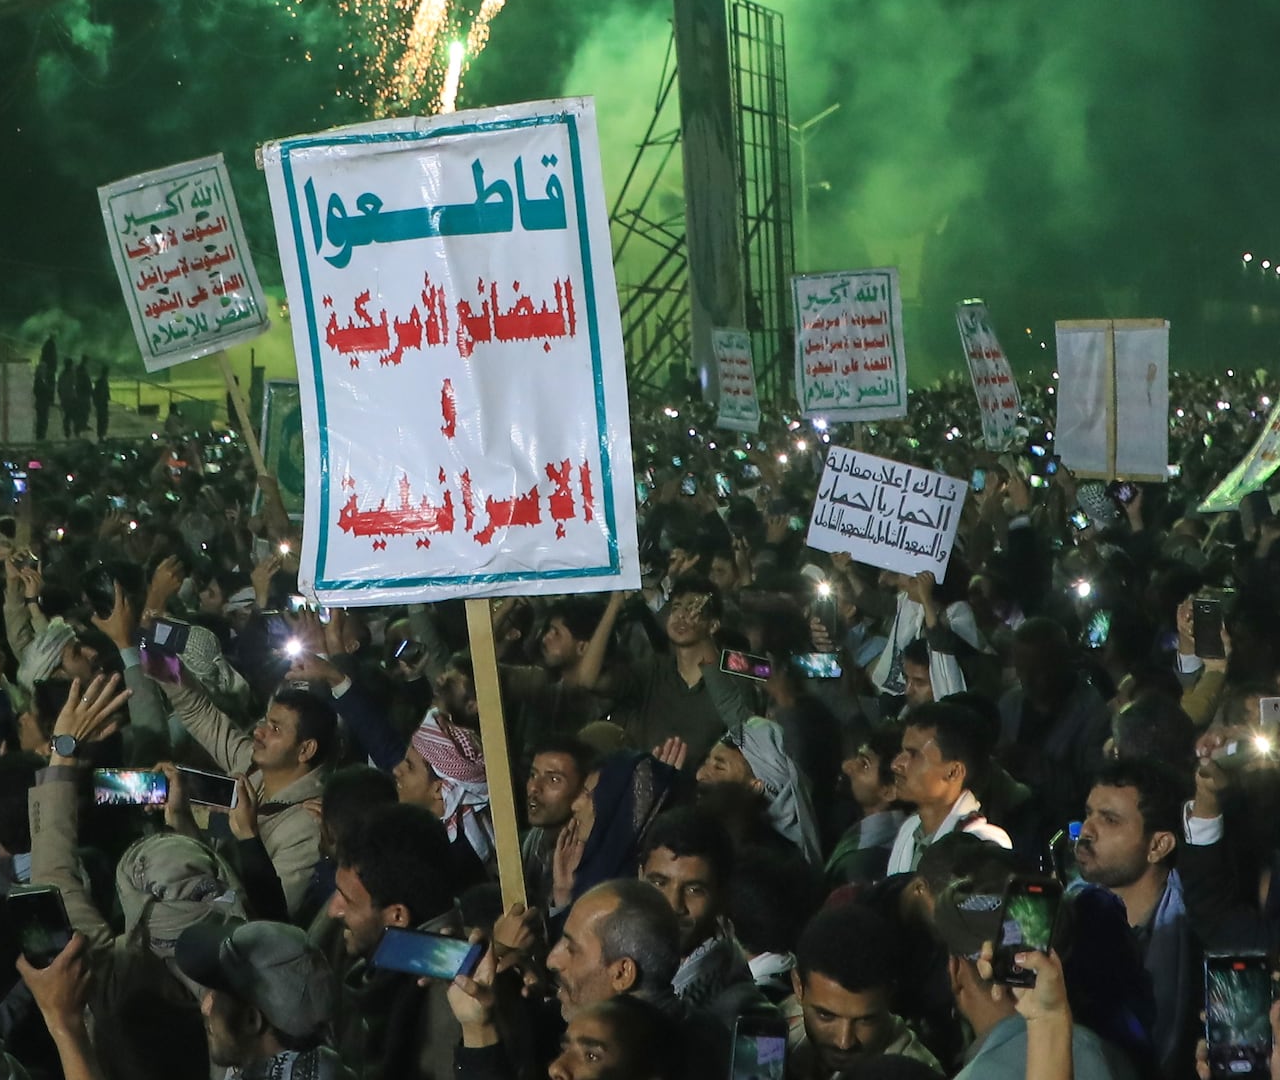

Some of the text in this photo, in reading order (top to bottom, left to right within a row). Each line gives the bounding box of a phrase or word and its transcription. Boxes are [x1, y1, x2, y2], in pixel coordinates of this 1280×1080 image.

[122, 179, 221, 235] الله أكبر
[304, 154, 566, 268] قاطعوا
[183, 216, 228, 243] الموت
[136, 244, 235, 291] الموت لإسرائيل
[144, 292, 183, 319] اليهود
[187, 285, 209, 309] على
[803, 279, 885, 312] الله أكبر
[151, 312, 208, 351] للإسلام
[322, 271, 577, 369] البضائع الأمريكية
[440, 378, 456, 438] و
[856, 376, 894, 402] النصر
[826, 452, 871, 481] معادلة
[337, 459, 593, 551] الإسرائيلية
